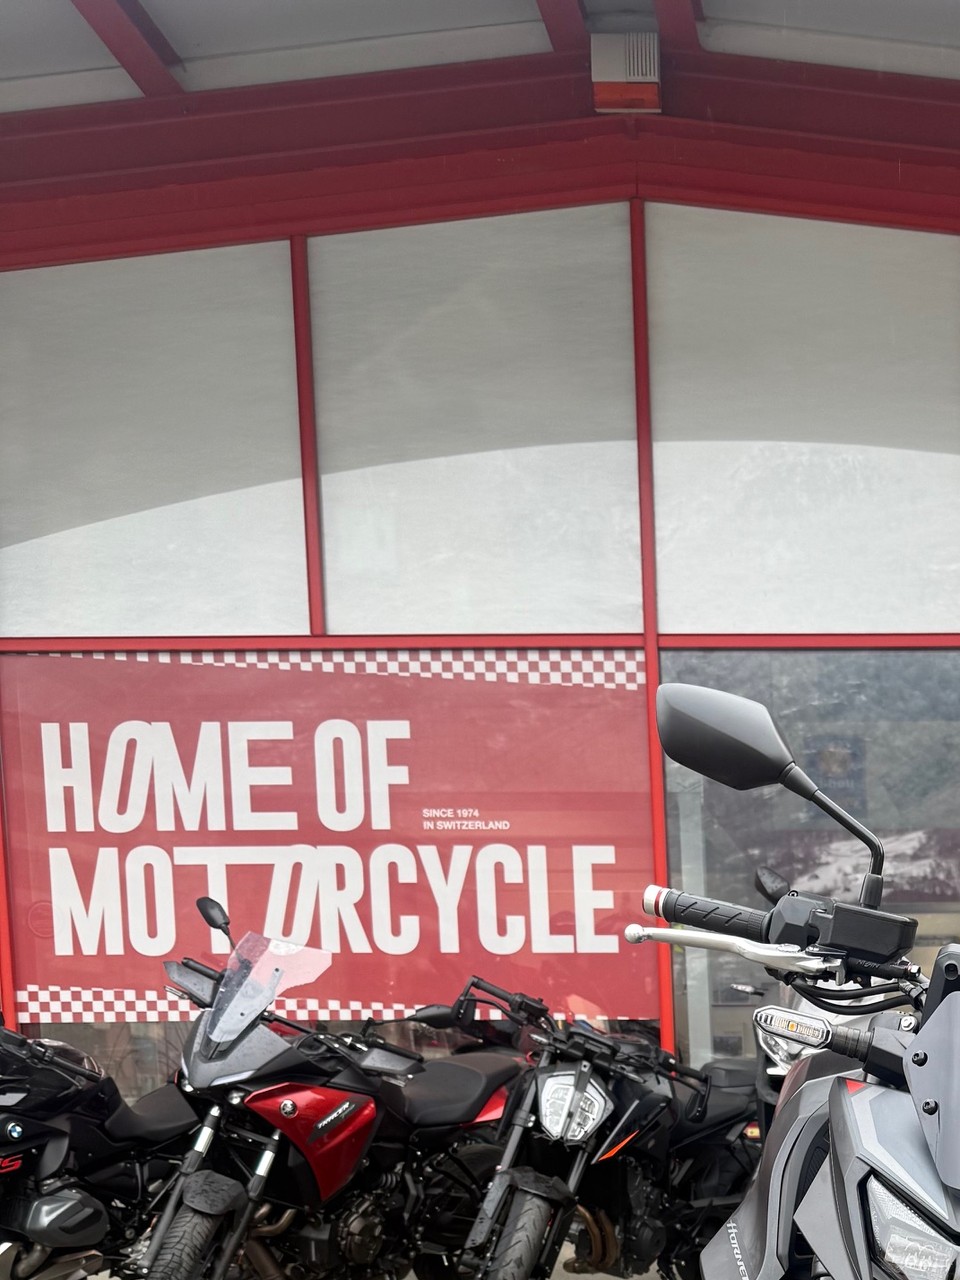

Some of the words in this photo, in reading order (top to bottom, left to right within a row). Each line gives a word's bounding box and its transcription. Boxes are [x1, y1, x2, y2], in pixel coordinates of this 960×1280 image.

[41, 720, 298, 834] HOME
[314, 719, 411, 832] OF
[422, 808, 455, 818] SINCE
[456, 808, 480, 818] 1974
[423, 821, 434, 830] IN
[436, 821, 511, 830] SWITZERLAND
[0, 1154, 24, 1173] S
